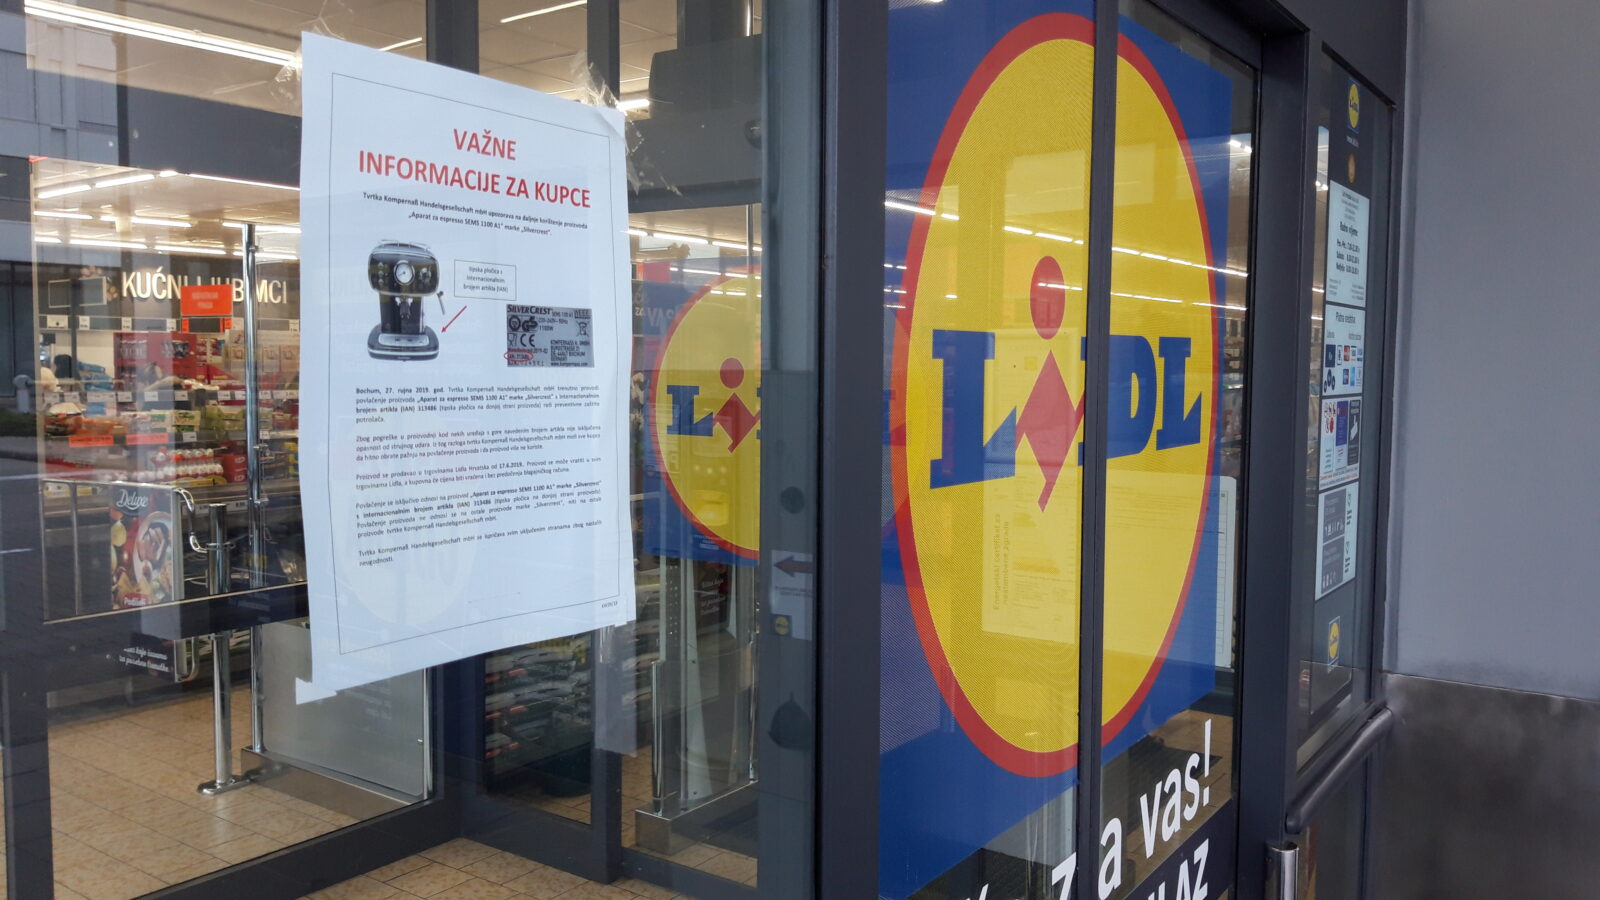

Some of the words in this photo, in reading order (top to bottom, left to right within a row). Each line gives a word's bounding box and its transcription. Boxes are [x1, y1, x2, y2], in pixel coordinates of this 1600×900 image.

[454, 128, 516, 160] VAŽNE
[359, 150, 500, 194] INFORMACIJE
[506, 176, 529, 199] ZA
[535, 180, 590, 208] KUPCE
[363, 192, 382, 201] Tvrtka
[384, 195, 418, 206] Kompernaß
[420, 201, 474, 214] Handelsgesellschaft
[488, 210, 514, 220] upozorava
[564, 222, 588, 230] proizvoda
[440, 216, 463, 224] espresso
[359, 549, 376, 557] Tvrtka
[1140, 719, 1212, 859] vas!
